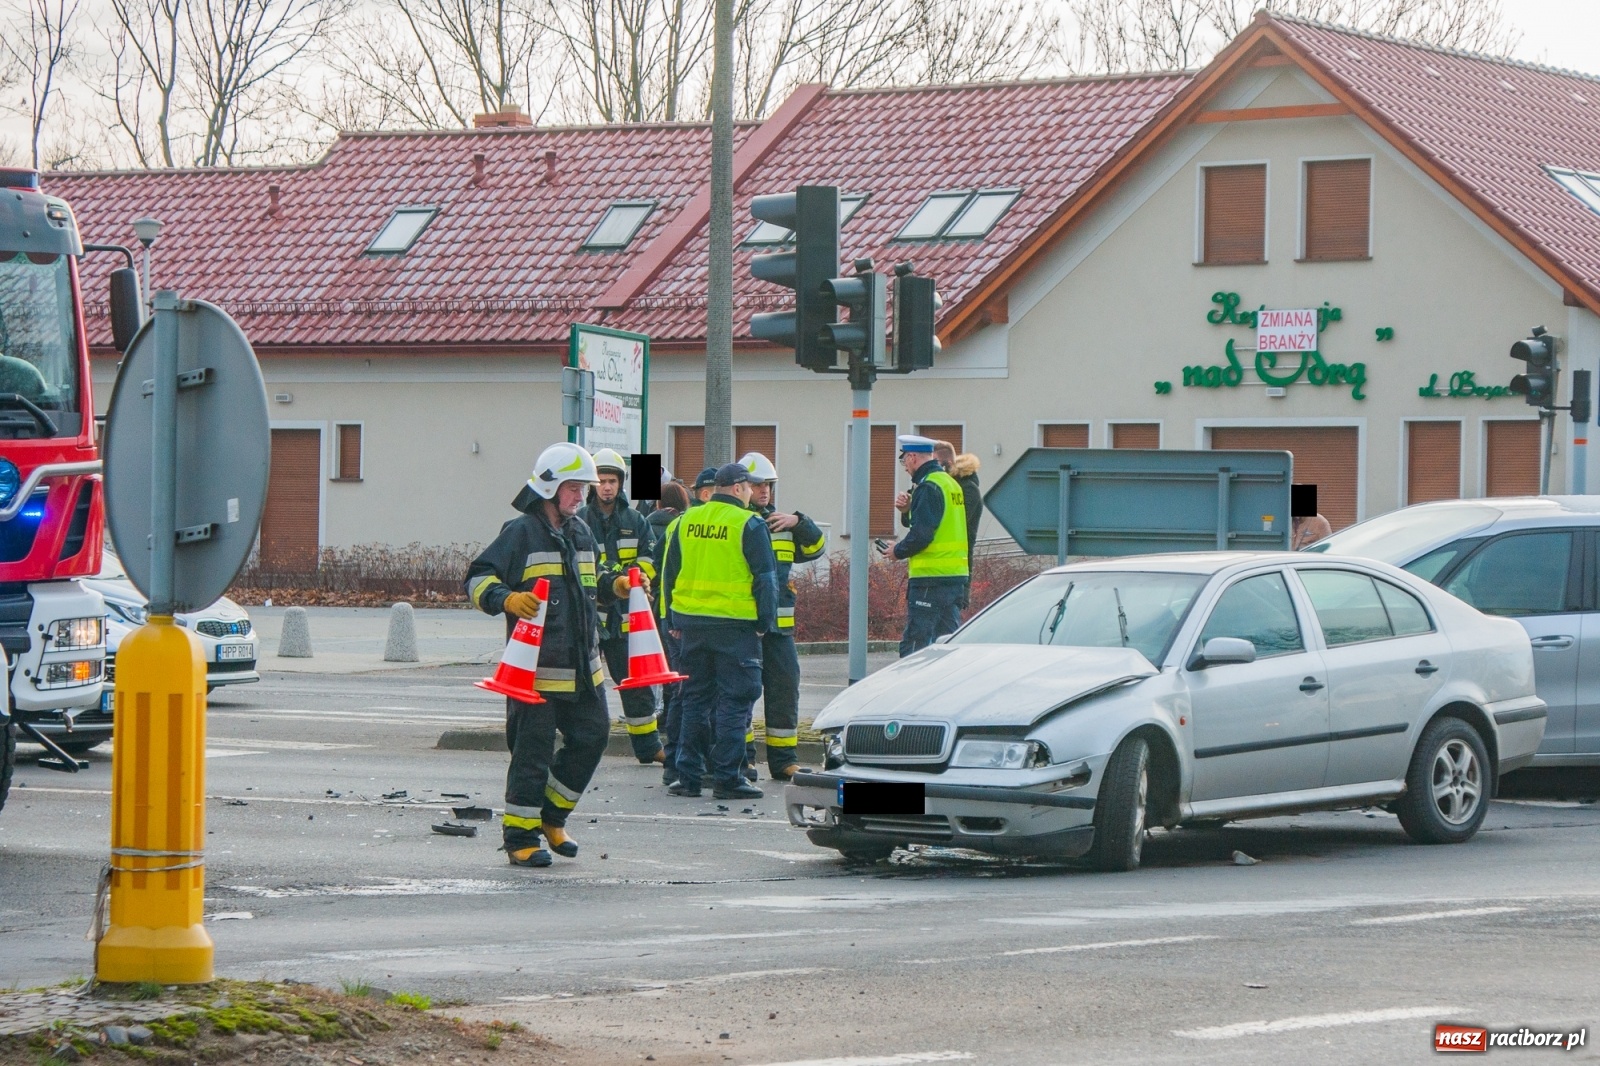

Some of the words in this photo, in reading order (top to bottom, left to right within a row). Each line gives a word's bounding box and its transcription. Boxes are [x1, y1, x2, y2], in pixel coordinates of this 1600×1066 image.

[1260, 311, 1314, 328] ZMIANA
[1258, 331, 1316, 350] BRANŻY
[687, 524, 728, 540] POLICJA
